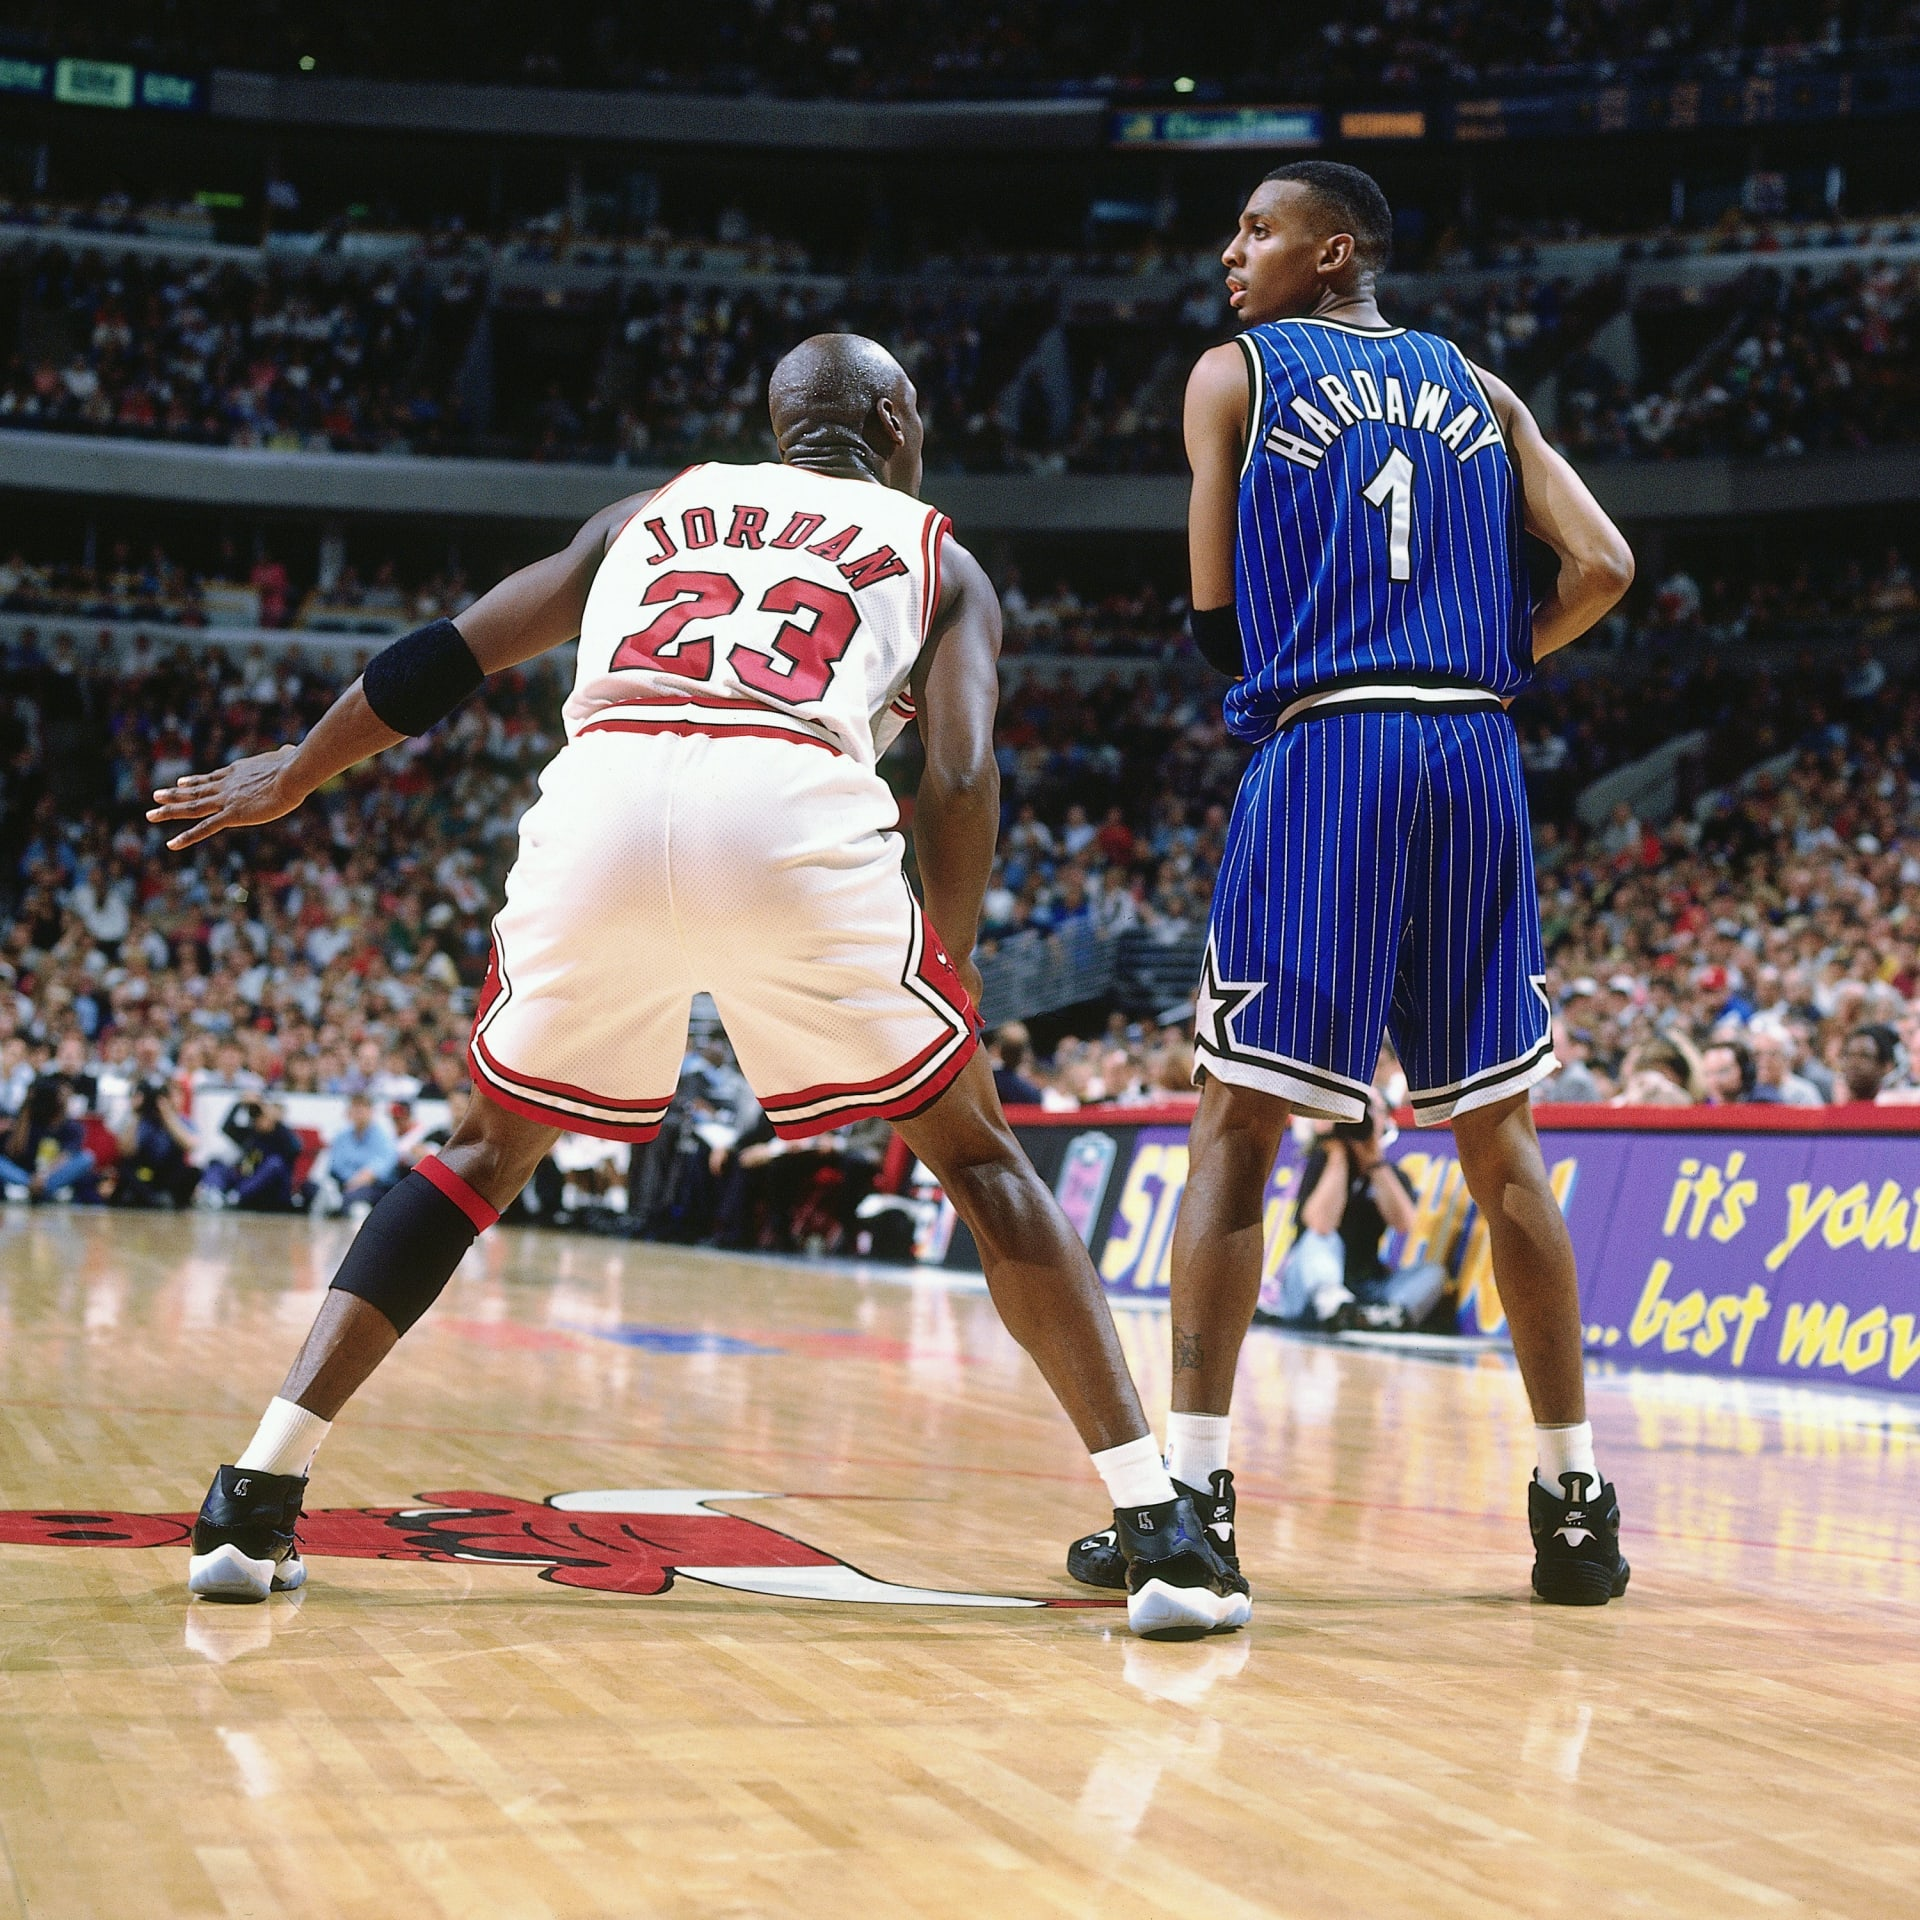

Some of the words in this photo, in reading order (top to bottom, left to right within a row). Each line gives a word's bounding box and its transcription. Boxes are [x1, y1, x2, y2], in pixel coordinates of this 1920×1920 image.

[1264, 369, 1501, 470] HARDAWAY
[644, 505, 910, 591] JORDAN
[1361, 446, 1415, 583] 1
[608, 570, 862, 706] 23
[1663, 1150, 1758, 1243] it's
